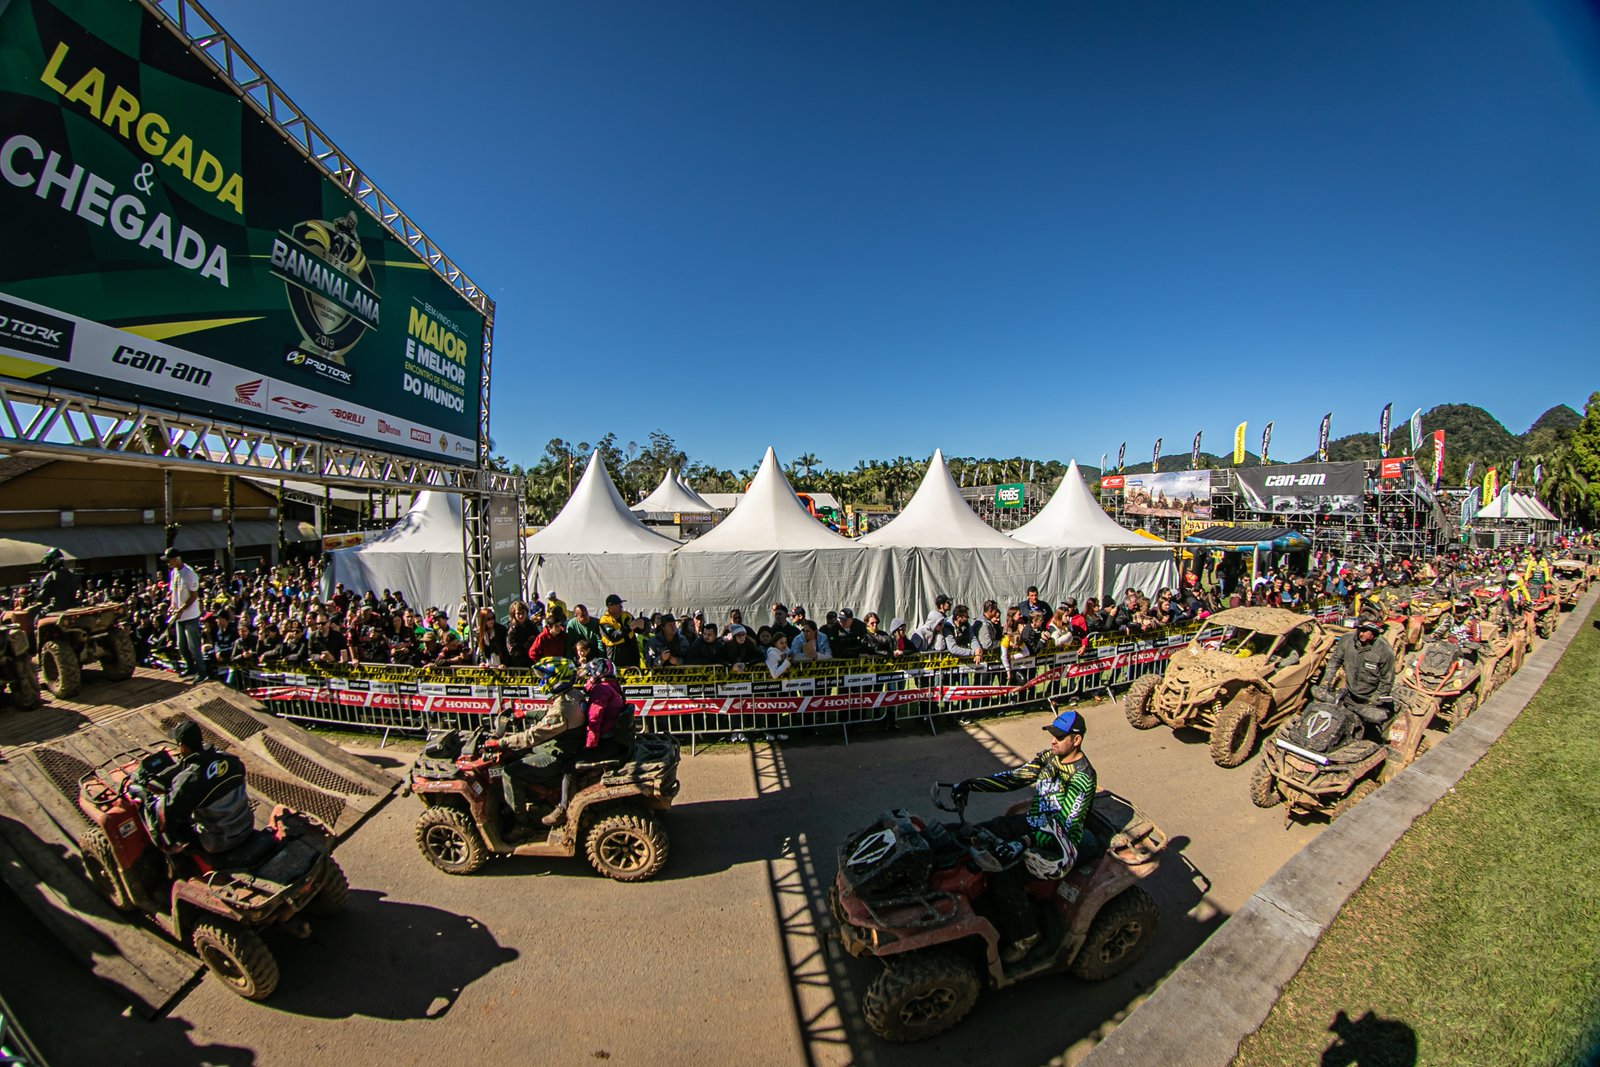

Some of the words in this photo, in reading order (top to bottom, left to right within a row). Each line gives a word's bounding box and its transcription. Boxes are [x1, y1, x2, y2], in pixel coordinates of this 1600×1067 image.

[40, 41, 245, 215] LARGADA
[133, 162, 154, 196] &
[0, 134, 230, 288] CHEGADA
[270, 238, 380, 325] BANANALAMA
[424, 302, 452, 328] BEM-VINDO
[10, 318, 63, 345] TORK
[408, 306, 467, 366] MAIOR
[315, 333, 335, 349] 2019
[111, 345, 213, 387] can-am
[305, 357, 327, 372] PRO
[327, 366, 352, 381] TORK
[405, 338, 416, 360] E
[417, 344, 466, 386] MELHOR
[404, 361, 434, 381] ENCONTRO
[434, 375, 441, 385] DE
[403, 373, 422, 395] DO
[423, 382, 465, 413] MUNDO!
[234, 397, 262, 408] HONDA
[271, 396, 318, 410] CRF
[334, 408, 366, 425] BORILLI
[411, 429, 431, 442] MOTUL
[1265, 473, 1326, 487] can-am
[653, 667, 686, 675] TORK
[1080, 660, 1112, 672] HONDA
[647, 675, 673, 683] PRO
[383, 697, 424, 707] HONDA
[824, 697, 873, 707] HONDA
[898, 690, 940, 701] HONDA
[445, 700, 491, 709] HONDA
[746, 701, 798, 709] HONDA
